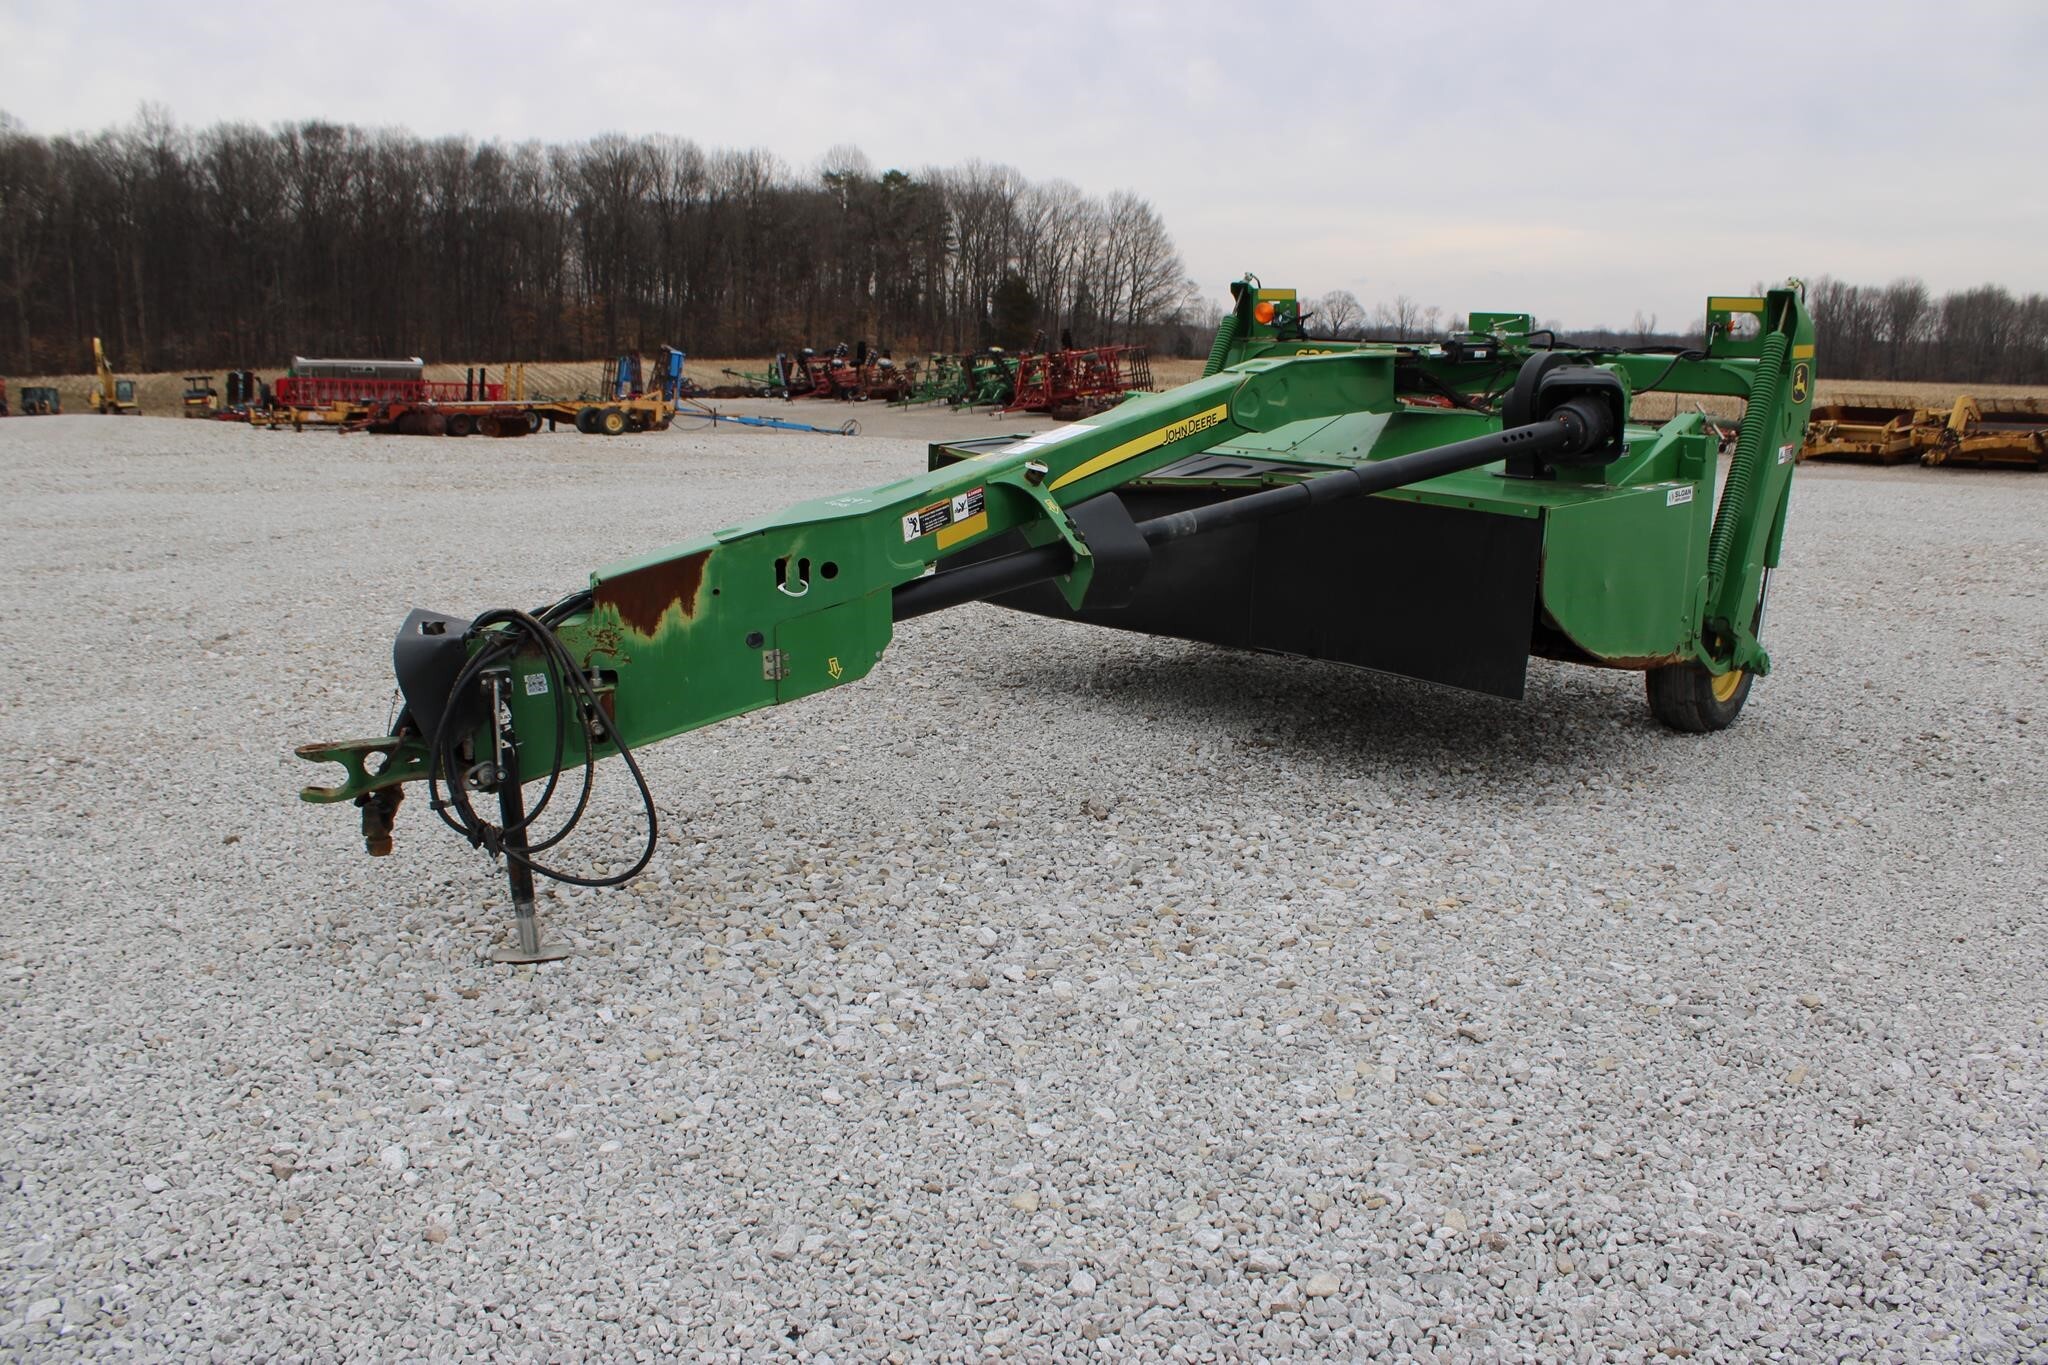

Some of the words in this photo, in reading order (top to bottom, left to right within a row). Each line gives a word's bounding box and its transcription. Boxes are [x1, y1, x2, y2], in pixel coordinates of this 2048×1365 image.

[1163, 425, 1188, 444] JOHN
[1188, 413, 1218, 434] DEERE
[1675, 488, 1692, 498] SLOAN
